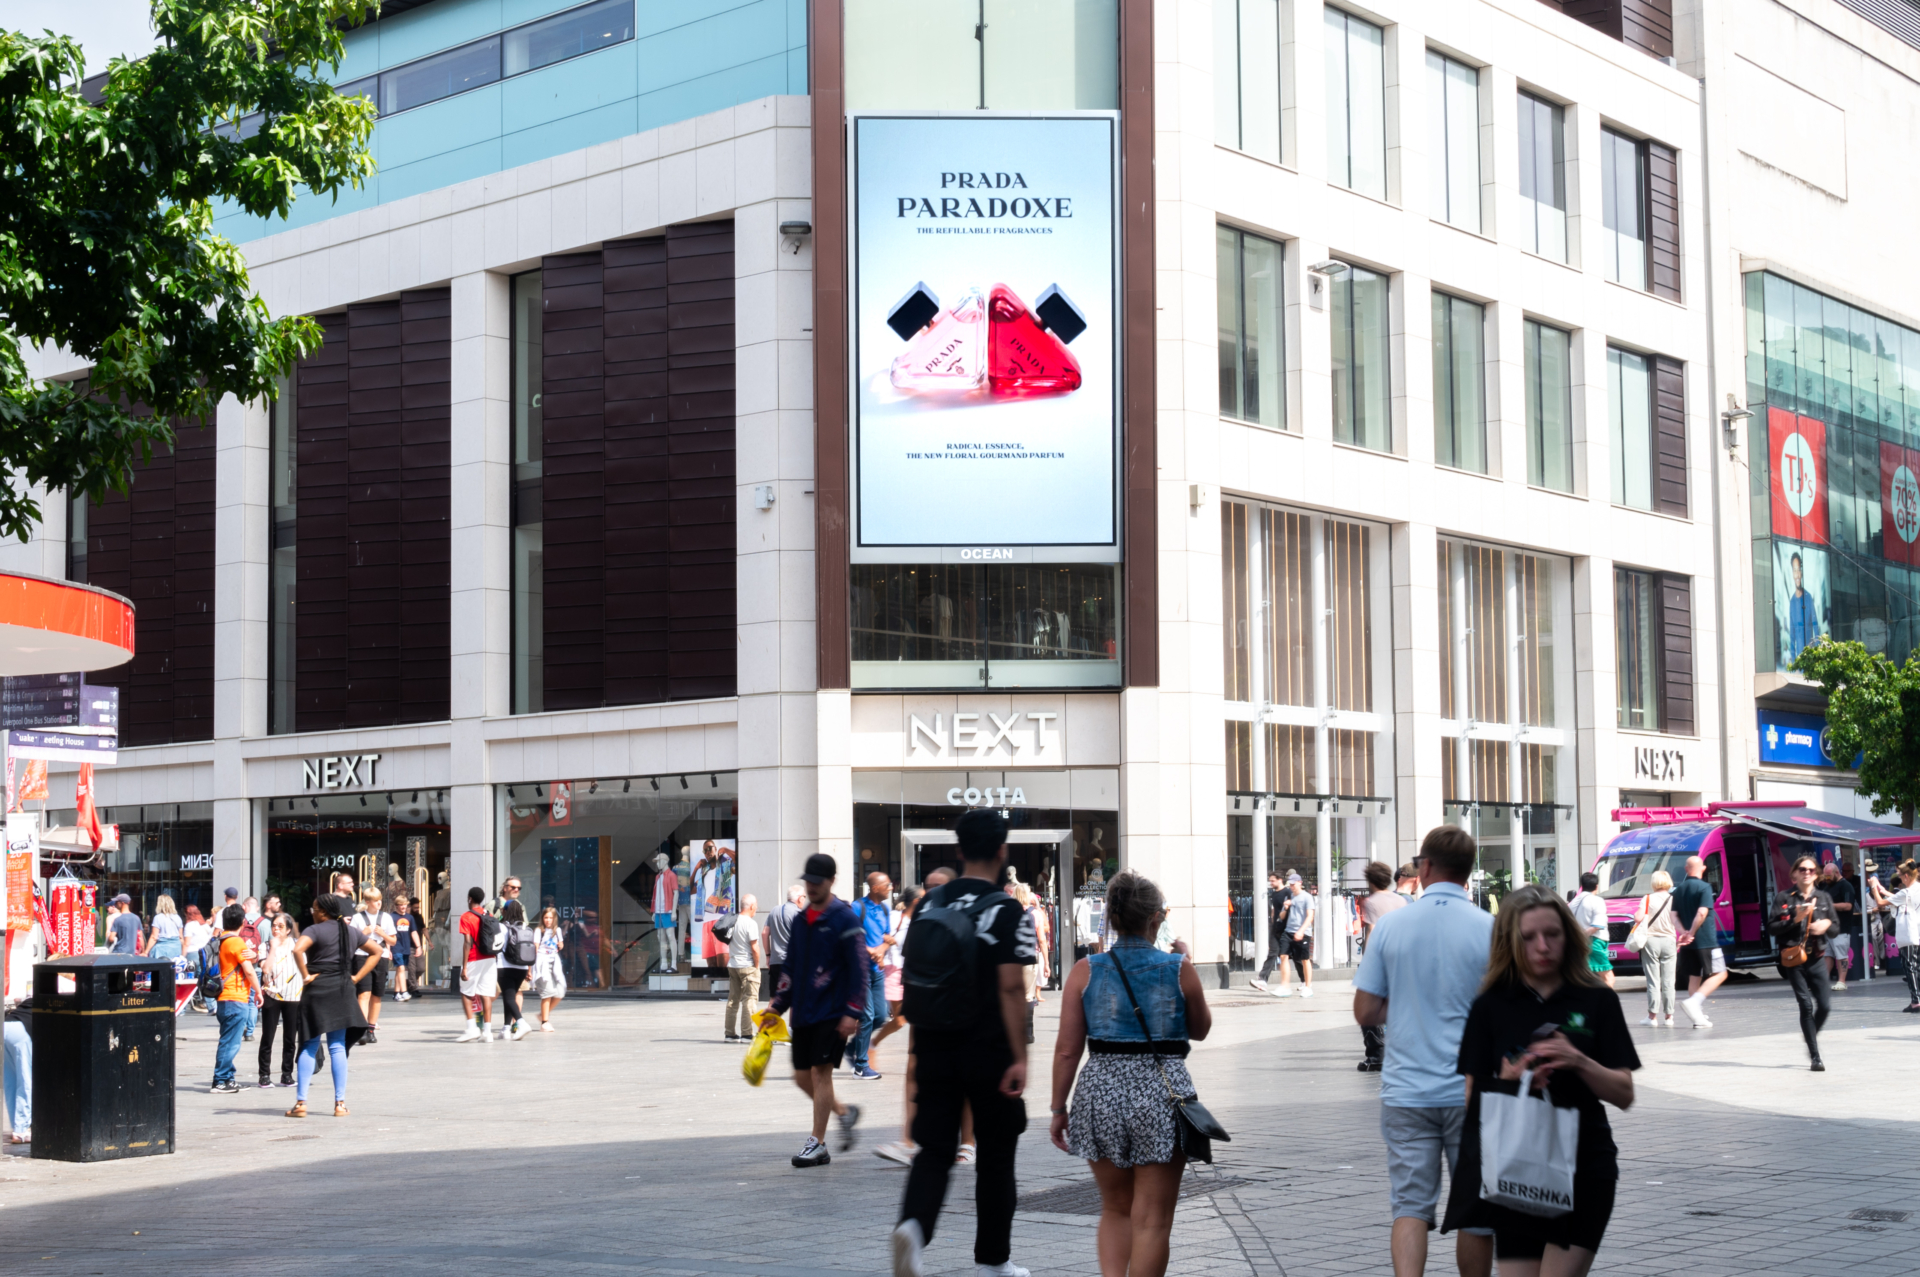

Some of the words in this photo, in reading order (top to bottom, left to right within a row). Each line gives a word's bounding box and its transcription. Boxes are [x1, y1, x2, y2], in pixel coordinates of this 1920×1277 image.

[940, 172, 1028, 188] PRADA
[897, 198, 1073, 218] PARADOXE
[925, 338, 963, 373] PRADA
[1010, 338, 1045, 374] PRADA
[1895, 486, 1916, 512] 70%
[1897, 508, 1917, 533] OFF
[960, 548, 1012, 559] OCEAN
[3, 704, 23, 712] Maritime
[25, 703, 44, 711] Museum
[2, 718, 24, 728] Liverpool
[44, 715, 60, 724] Station
[910, 712, 1057, 748] NEXT
[16, 733, 37, 742] uake
[40, 735, 64, 746] eeting
[65, 737, 84, 746] House
[1785, 731, 1812, 748] pharmacy
[303, 754, 382, 789] NEXT
[1635, 746, 1684, 782] NEXT
[947, 787, 1026, 806] COSTA
[554, 906, 585, 918] NEXT
[74, 911, 82, 954] LIVERPOO
[49, 999, 65, 1007] Litter
[122, 997, 145, 1006] Litter
[1498, 1179, 1571, 1208] BERSHKA
